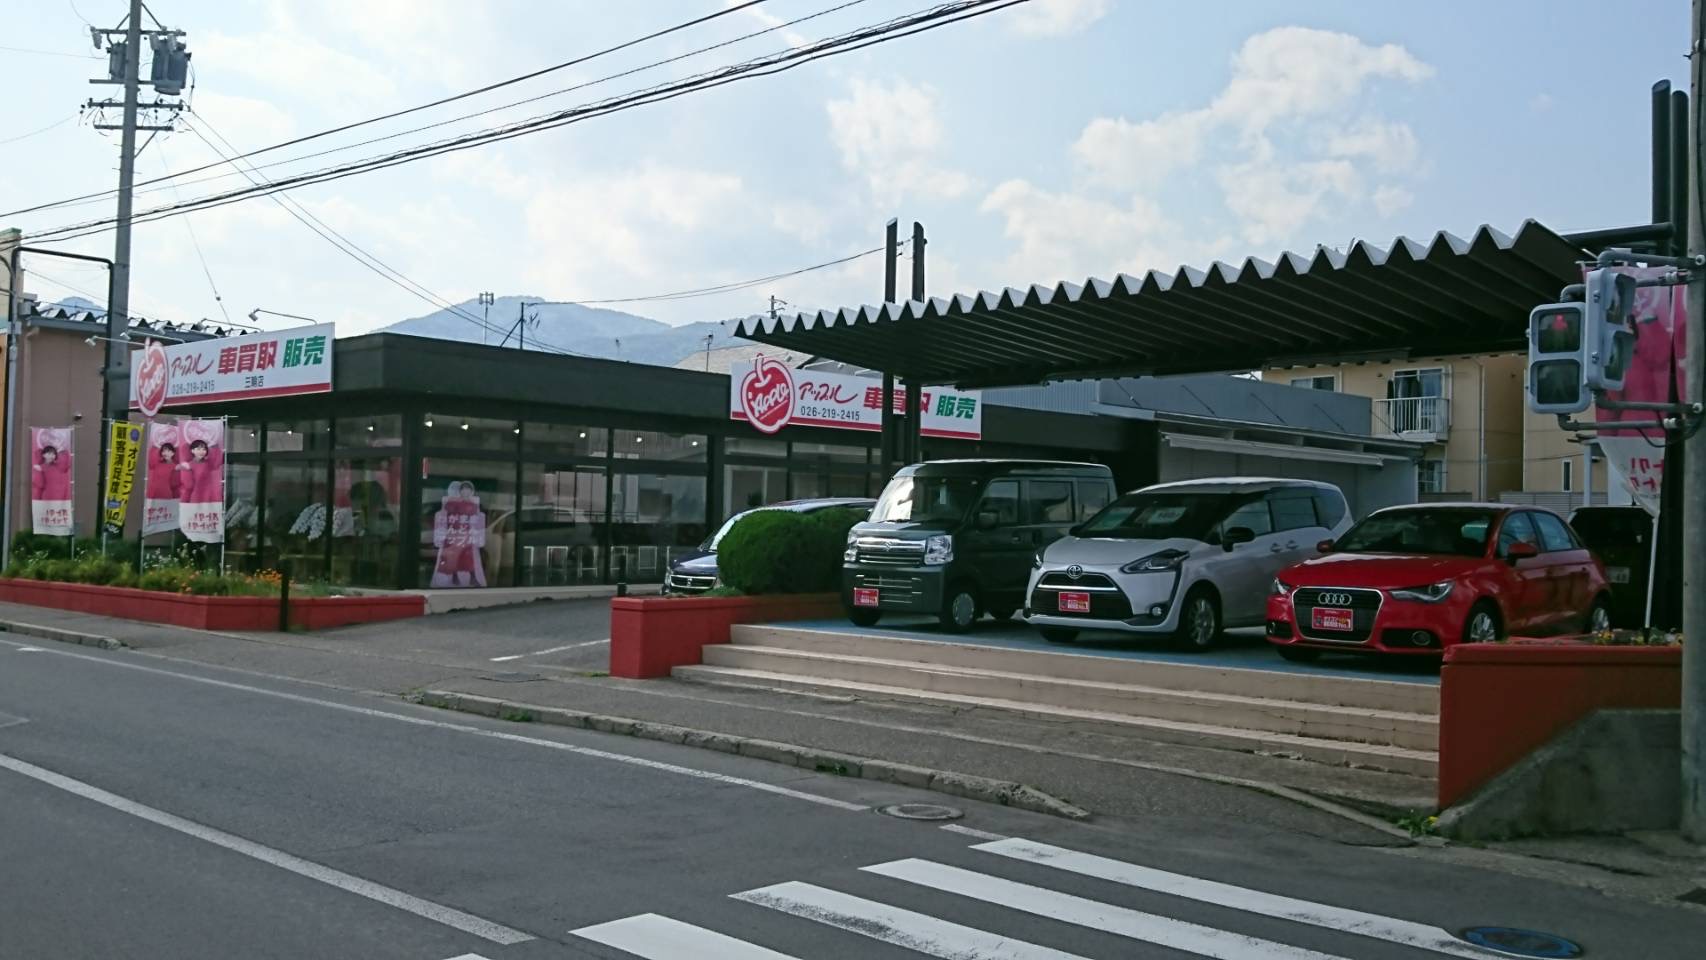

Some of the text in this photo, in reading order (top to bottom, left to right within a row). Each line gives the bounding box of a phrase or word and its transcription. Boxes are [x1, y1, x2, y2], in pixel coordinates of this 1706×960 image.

[217, 340, 278, 375] 車買取
[282, 335, 326, 368] 販売
[800, 405, 860, 421] 026-219-2415
[936, 394, 977, 419] 販売
